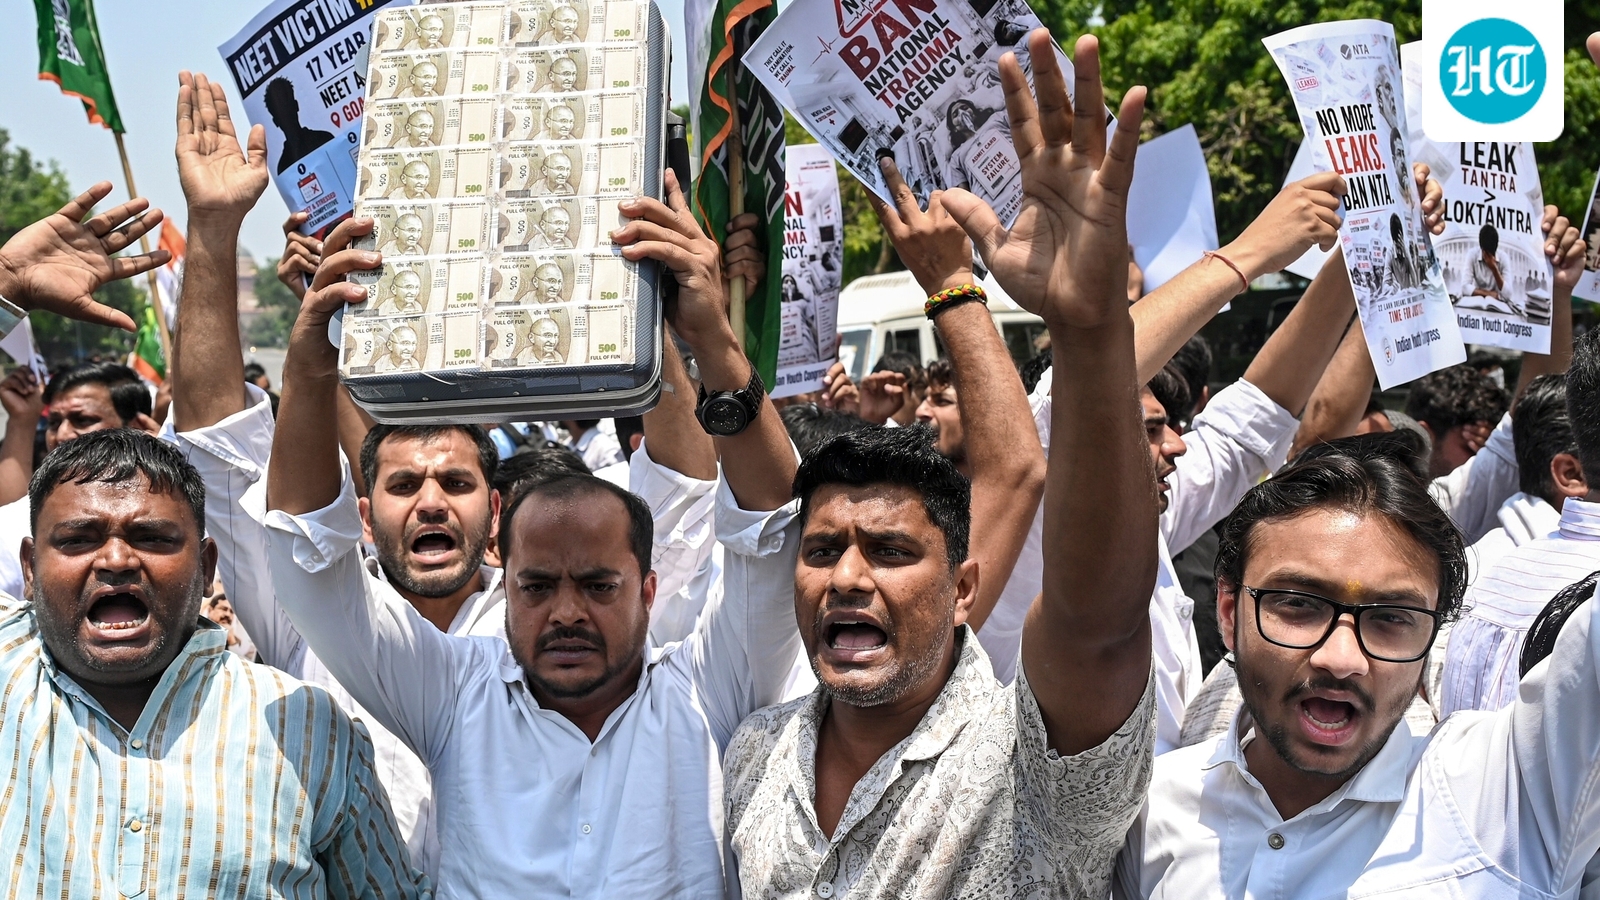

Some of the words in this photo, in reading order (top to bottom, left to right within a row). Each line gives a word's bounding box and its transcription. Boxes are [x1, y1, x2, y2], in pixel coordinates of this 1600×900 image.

[234, 31, 280, 91] NEET
[274, 0, 355, 56] VICTIM
[838, 0, 937, 81] BAN
[1352, 44, 1370, 55] NTA
[305, 56, 324, 82] 17
[324, 31, 366, 69] YEAR
[764, 55, 774, 68] THEY
[773, 45, 783, 57] CALL
[864, 12, 950, 96] NATIONAL
[774, 70, 781, 78] WE
[780, 60, 789, 72] CALL
[876, 28, 962, 109] TRAUMA
[320, 77, 352, 108] NEET
[895, 46, 971, 124] AGENCY.
[1297, 78, 1317, 88] LEAKED
[1316, 108, 1340, 136] NO
[1340, 104, 1376, 132] MORE
[972, 150, 985, 163] ADMIT
[984, 137, 997, 150] CARD
[1325, 133, 1385, 175] LEAKS.
[1461, 142, 1517, 175] LEAK
[982, 151, 1004, 175] SYSTEM
[986, 156, 1010, 181] FAILURE
[465, 185, 482, 193] 500
[1342, 176, 1369, 211] BAN
[1368, 173, 1395, 206] NTA.
[1462, 168, 1516, 193] TANTRA
[998, 206, 1007, 218] THIS
[1010, 194, 1019, 205] NOT
[1444, 199, 1532, 235] LOKTANTRA
[458, 239, 475, 247] 500
[456, 292, 473, 301] 500
[600, 292, 618, 300] 500
[1389, 309, 1402, 323] TIME
[1403, 306, 1412, 320] FOR
[1457, 314, 1480, 329] Indian
[1482, 317, 1501, 332] Youth
[1504, 320, 1532, 338] Congress
[454, 349, 471, 358] 500
[598, 344, 616, 352] 500
[786, 372, 802, 384] Youth
